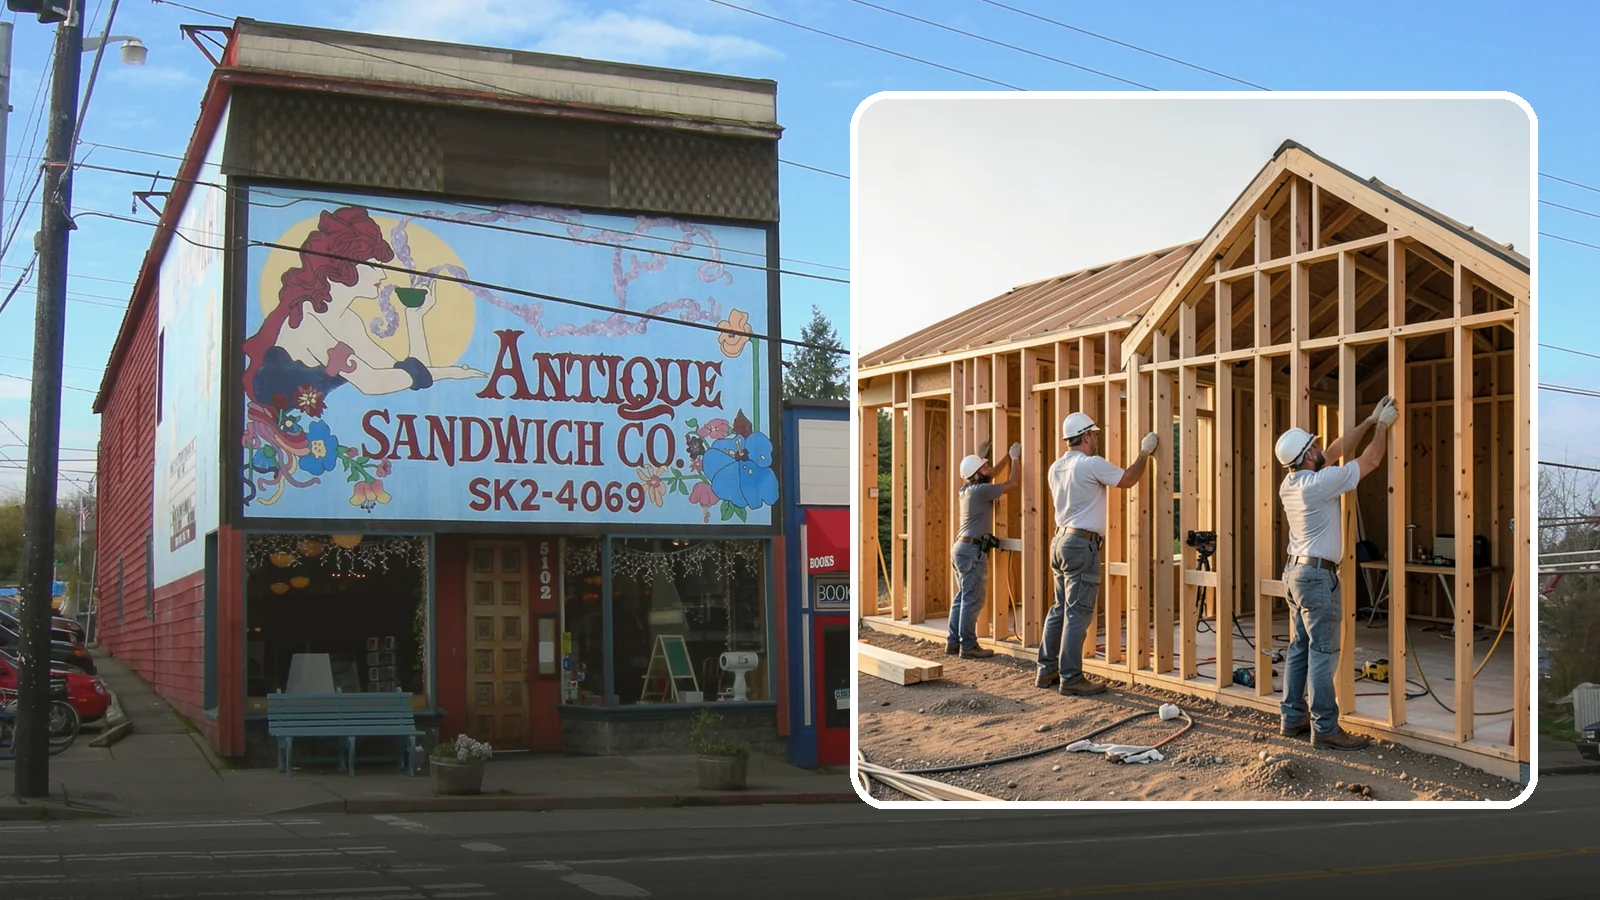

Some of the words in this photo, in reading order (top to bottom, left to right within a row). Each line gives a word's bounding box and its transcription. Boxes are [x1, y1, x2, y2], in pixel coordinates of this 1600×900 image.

[477, 329, 723, 421] ANTIQUE
[361, 408, 605, 467] SANDWICH
[617, 422, 686, 469] CO.
[468, 477, 646, 513] SK2-4069
[539, 541, 552, 600] 5102
[809, 555, 835, 569] BOOKS
